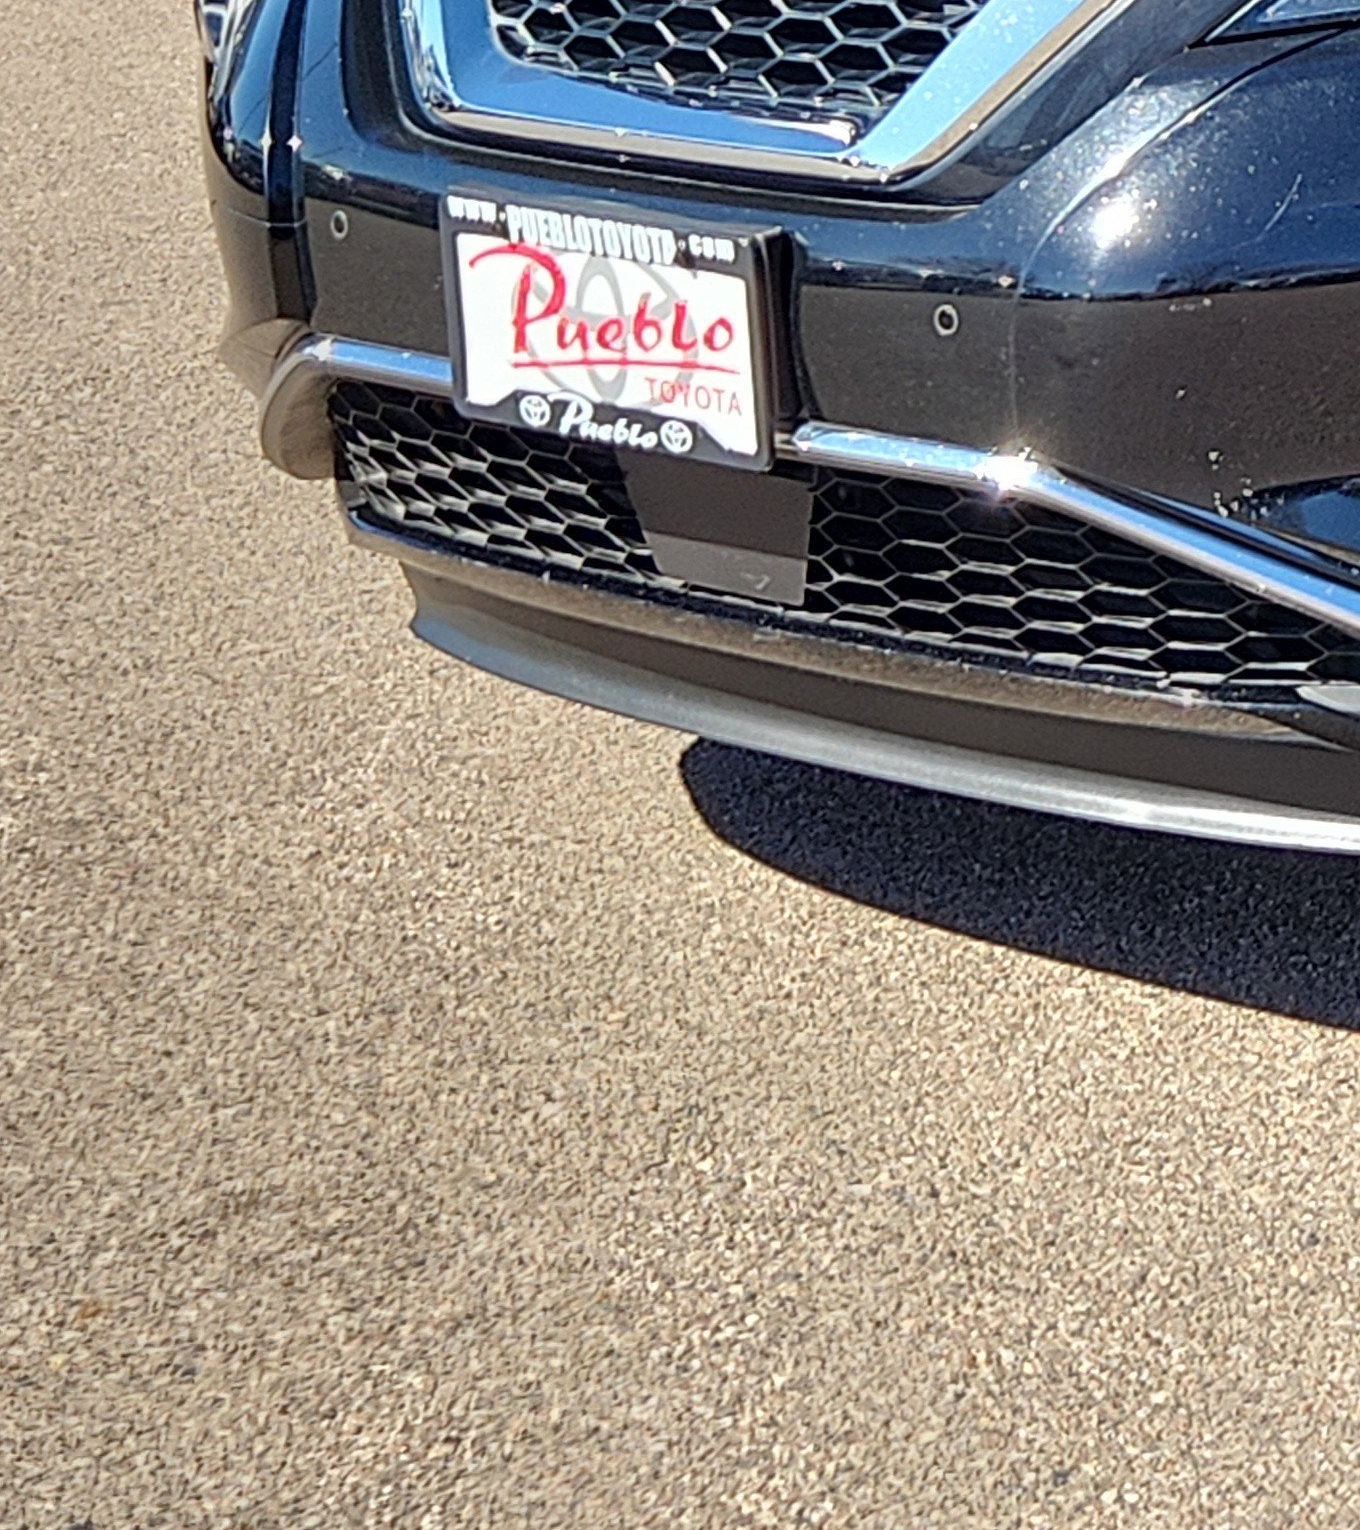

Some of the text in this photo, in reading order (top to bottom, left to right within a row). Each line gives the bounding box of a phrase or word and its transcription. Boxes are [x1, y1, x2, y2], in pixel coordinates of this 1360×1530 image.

[468, 241, 734, 354] Pueblo
[547, 390, 659, 449] Pueblo
[645, 377, 743, 417] TOYOTA
